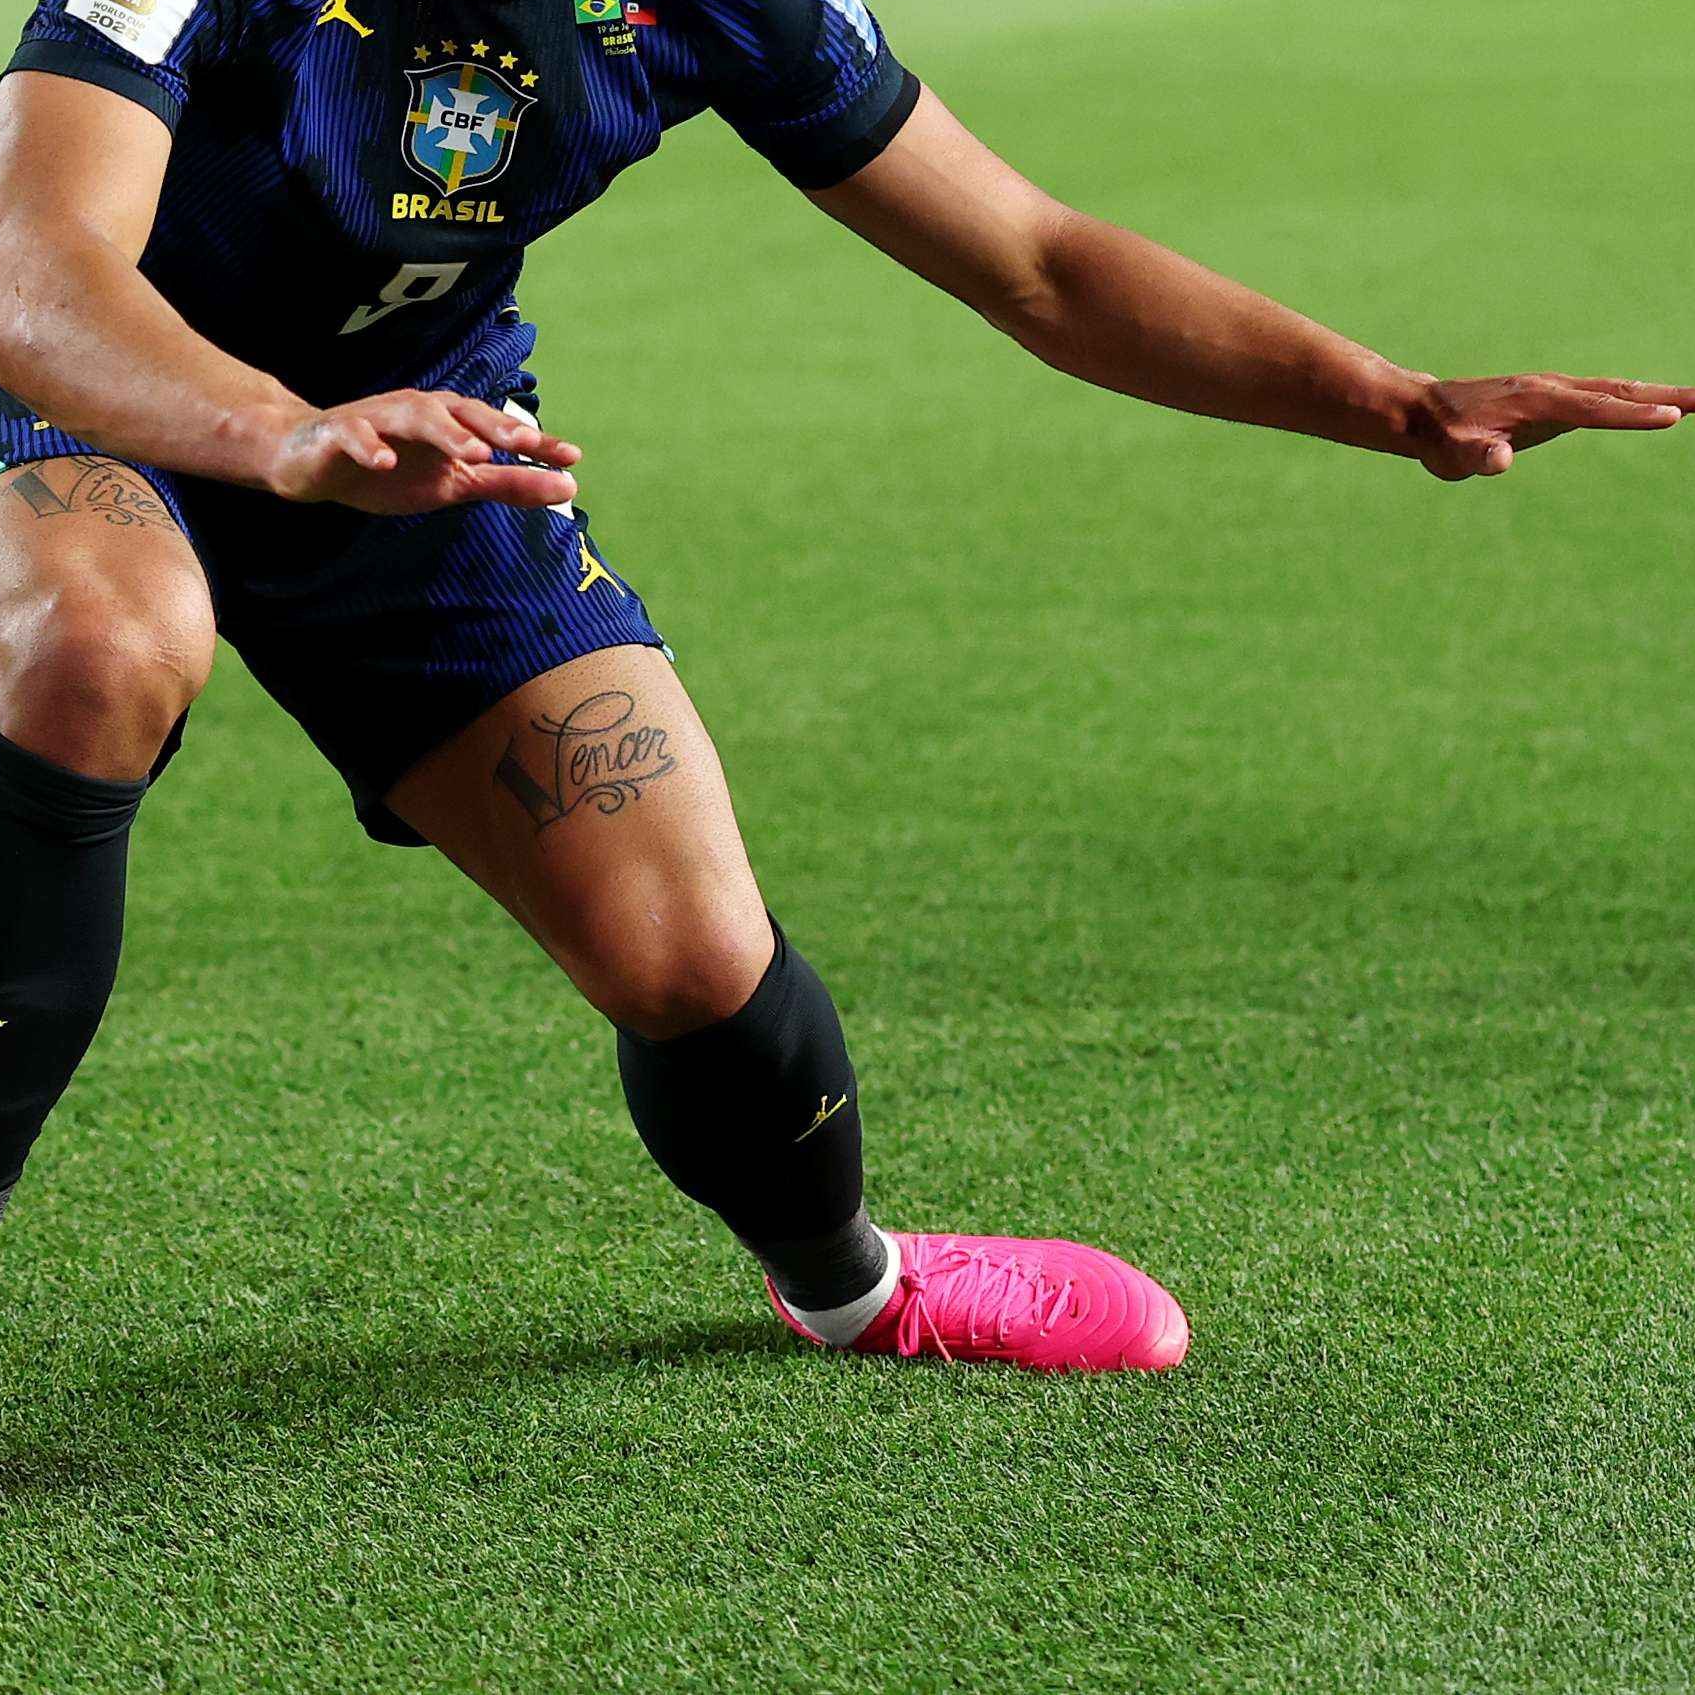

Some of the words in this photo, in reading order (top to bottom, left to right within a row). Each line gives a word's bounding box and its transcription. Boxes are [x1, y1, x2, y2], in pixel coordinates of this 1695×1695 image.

[93, 1, 126, 19] WORLD
[440, 110, 485, 131] CBF
[392, 193, 504, 223] BRASIL
[337, 261, 471, 335] 9
